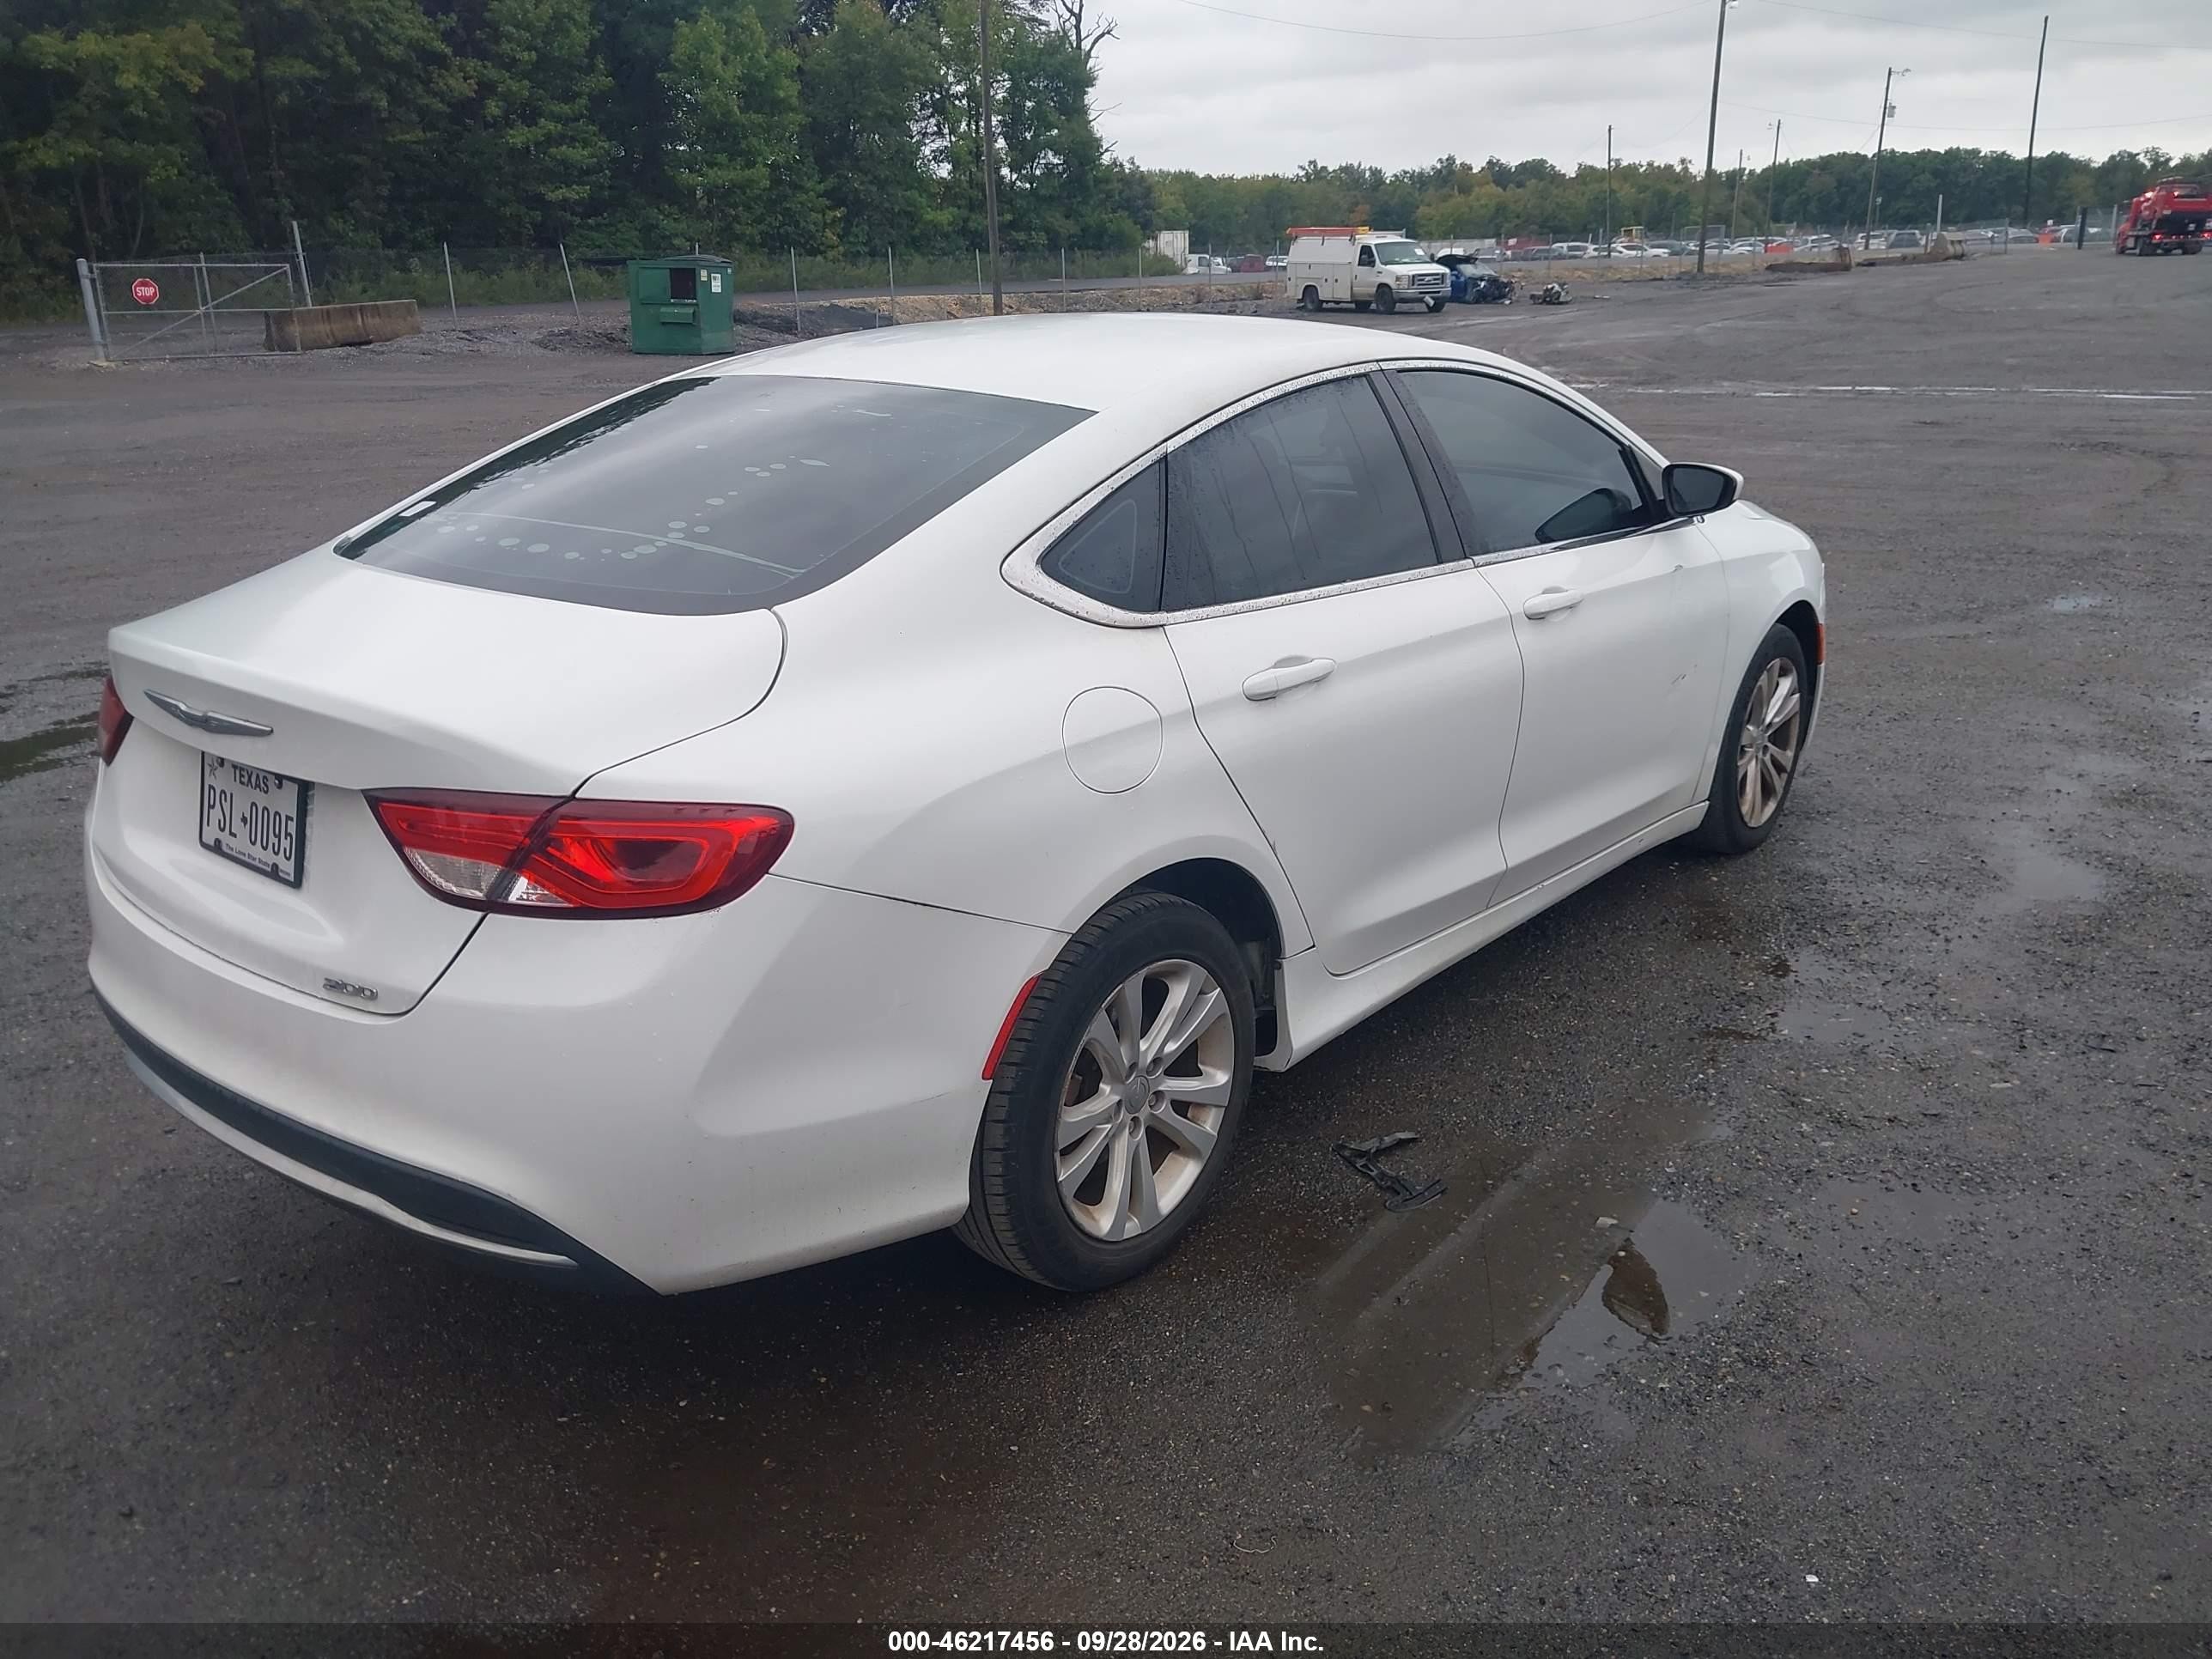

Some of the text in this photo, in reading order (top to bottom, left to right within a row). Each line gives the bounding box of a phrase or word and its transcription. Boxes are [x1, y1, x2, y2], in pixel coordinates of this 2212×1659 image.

[137, 287, 155, 296] STOP
[231, 764, 269, 794] TEXAS
[206, 784, 294, 861] PSL 0095
[323, 978, 378, 1000] 200
